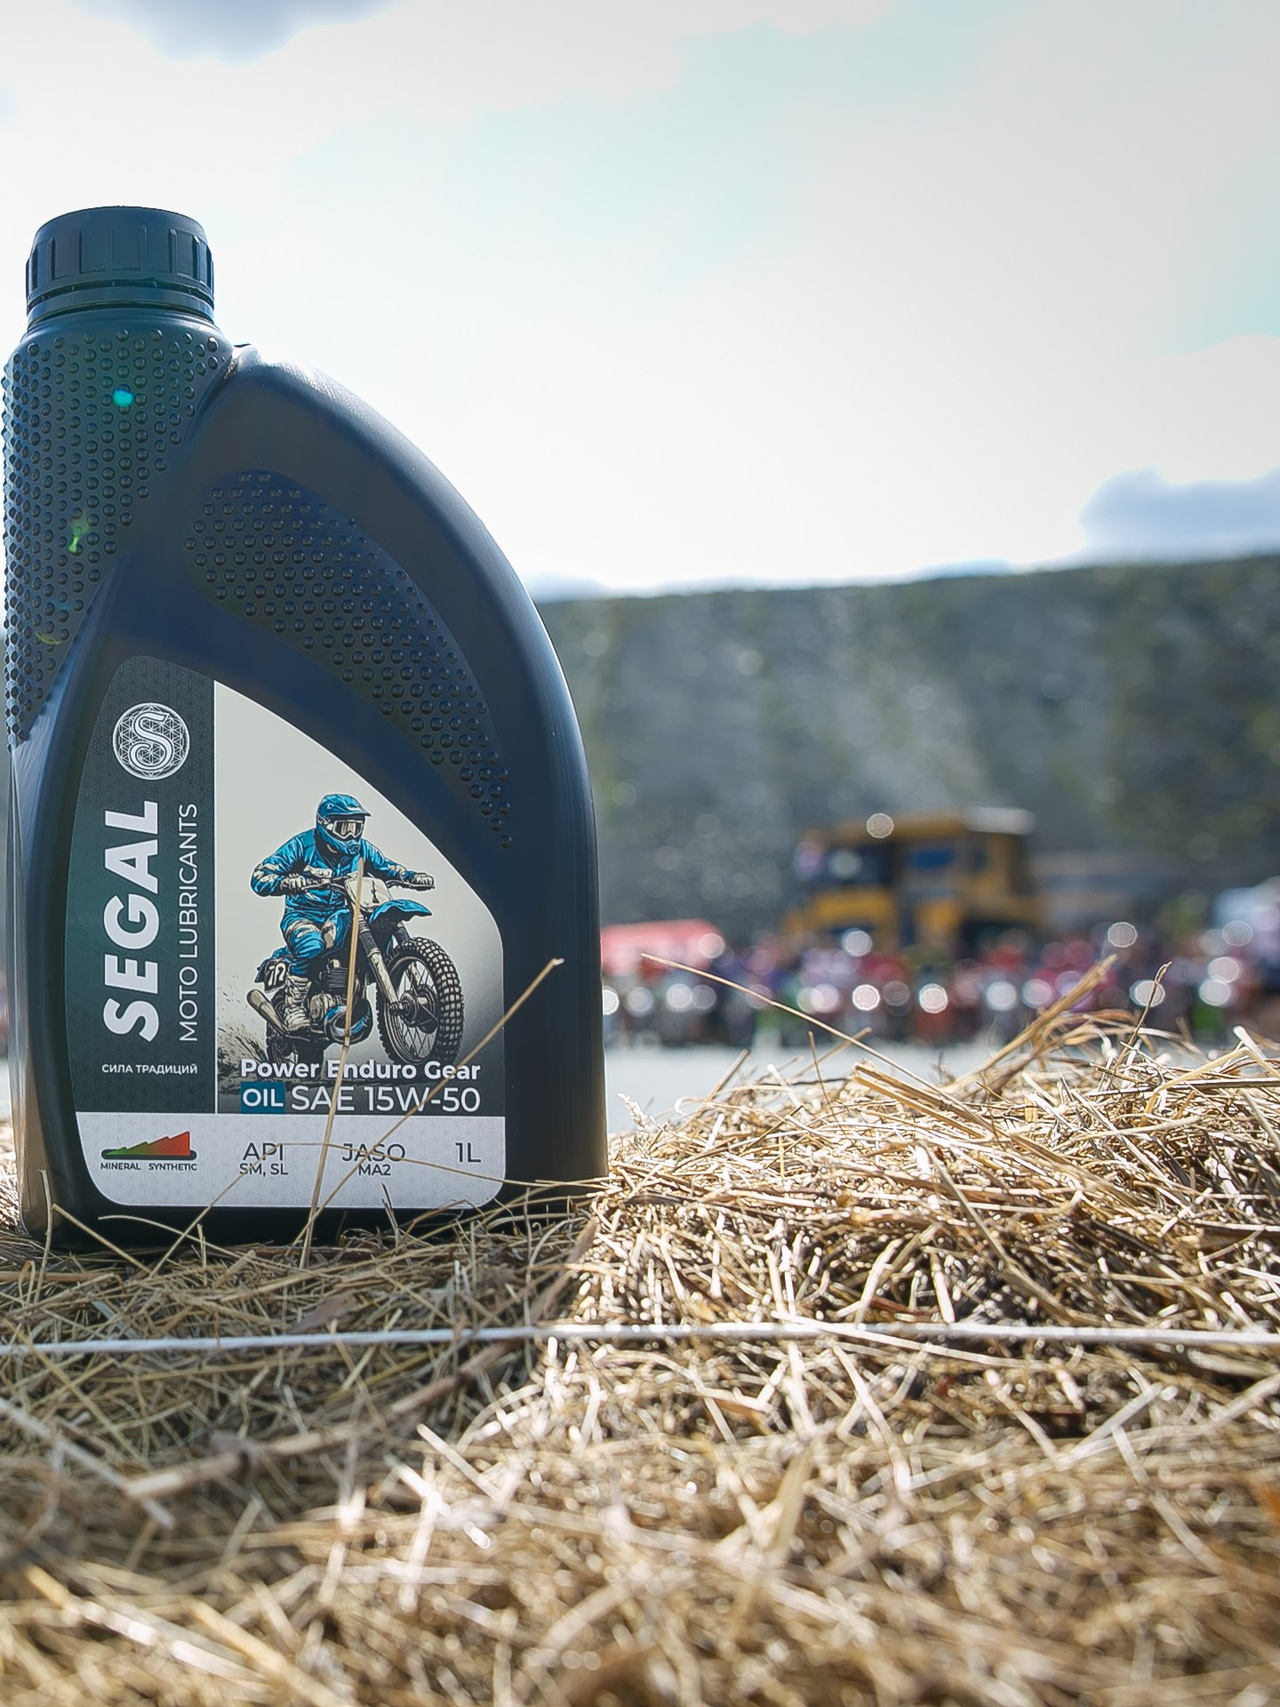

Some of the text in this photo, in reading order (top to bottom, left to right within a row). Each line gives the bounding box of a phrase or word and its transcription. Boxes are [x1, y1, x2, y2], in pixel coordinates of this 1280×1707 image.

[103, 800, 160, 1043] SEGAL
[178, 803, 199, 1042] MOTO LUBRICANTS
[101, 1063, 198, 1075] СИЛА ТРАДИЦИЙ
[240, 1058, 481, 1080] Power Enduro Gear
[242, 1085, 481, 1112] OIL SAE 15W-50
[242, 1142, 284, 1162] API
[341, 1143, 406, 1162] JASO
[455, 1142, 482, 1163] 1L
[100, 1162, 198, 1171] MINERAL SYNTHETIC
[239, 1163, 288, 1177] SM, SL
[358, 1163, 391, 1176] MA2
